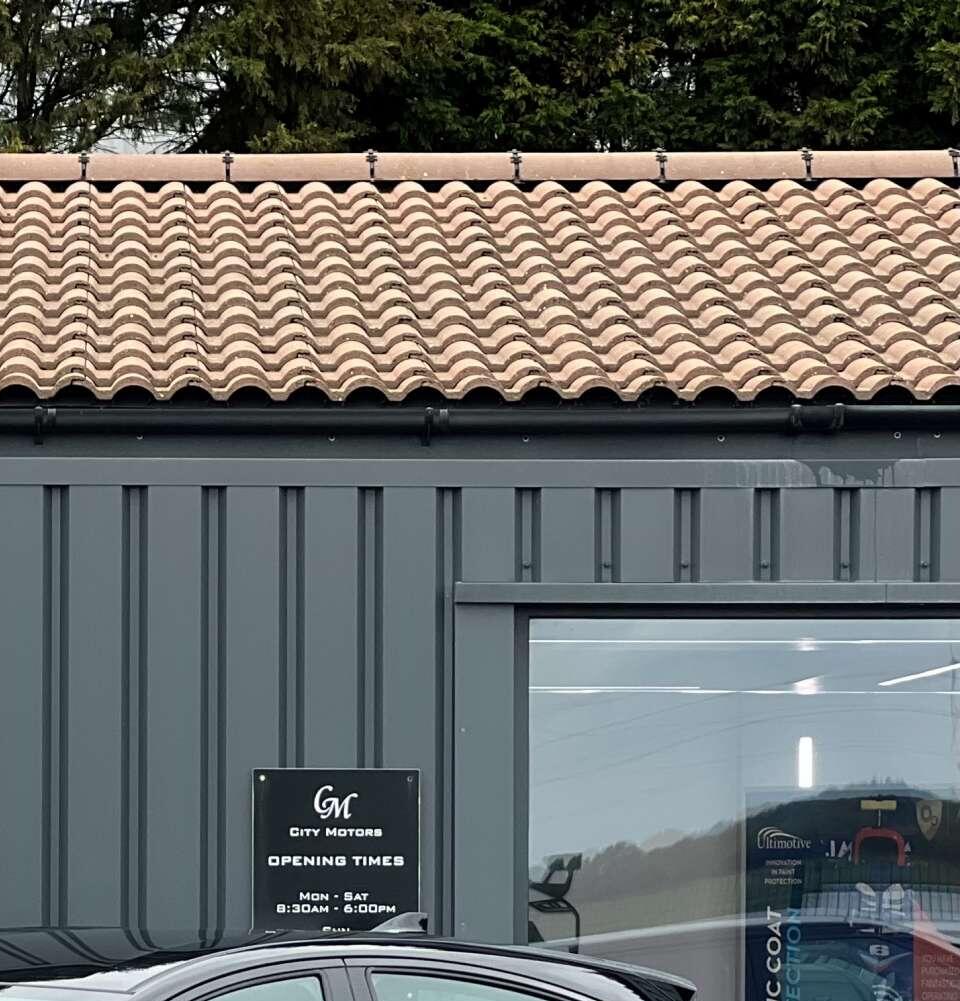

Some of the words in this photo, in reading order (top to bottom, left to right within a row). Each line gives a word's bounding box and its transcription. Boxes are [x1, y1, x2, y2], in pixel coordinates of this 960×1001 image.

[313, 785, 358, 819] CM
[289, 827, 320, 837] CITY
[325, 827, 383, 837] MOTORS
[757, 830, 812, 849] Ultimotive
[267, 855, 347, 867] OPENING
[352, 855, 404, 867] TIMES
[299, 892, 329, 902] MON
[343, 892, 369, 902] SAT
[276, 904, 329, 914] 8:30AM
[343, 904, 397, 914] 6:00PM
[766, 906, 783, 974] COAT
